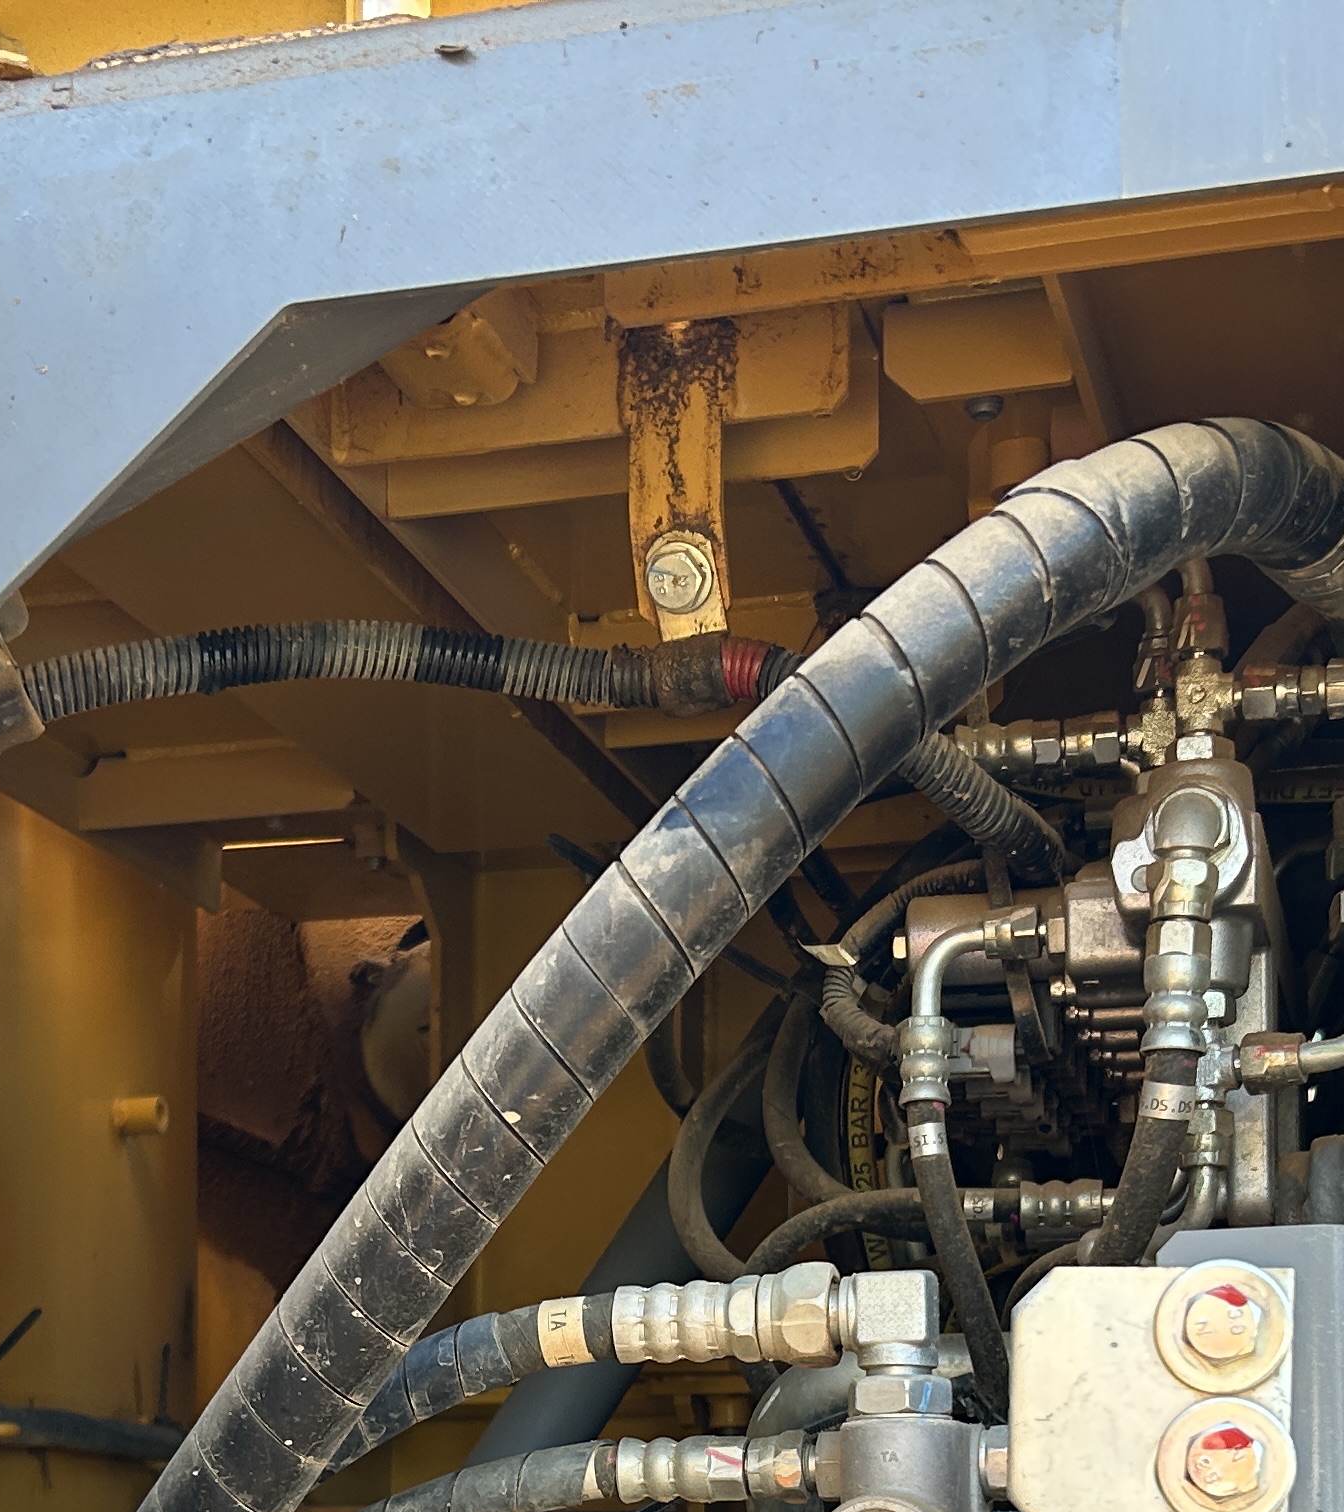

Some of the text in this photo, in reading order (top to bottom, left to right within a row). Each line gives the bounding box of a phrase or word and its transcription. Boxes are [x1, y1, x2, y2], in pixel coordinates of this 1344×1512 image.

[851, 1101, 870, 1148] BAR
[855, 1162, 871, 1193] 25
[879, 1450, 899, 1463] TA
